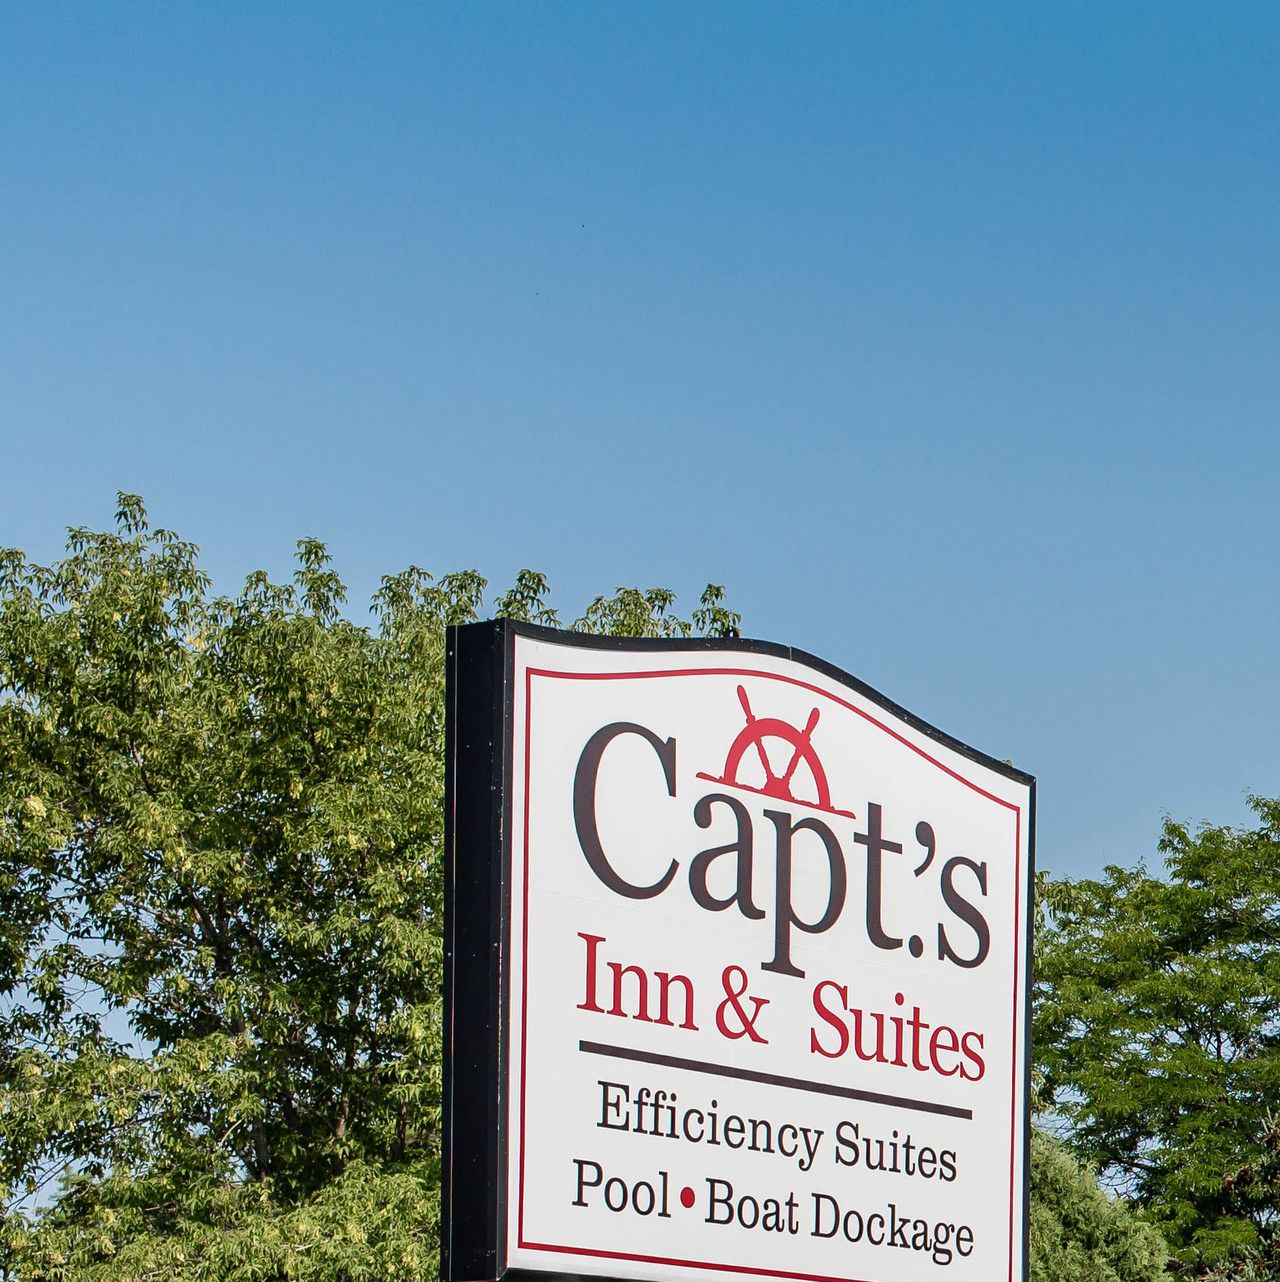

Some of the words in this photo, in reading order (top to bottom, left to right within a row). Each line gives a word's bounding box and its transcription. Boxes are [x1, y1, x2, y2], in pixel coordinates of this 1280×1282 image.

[576, 931, 699, 1032] Inn
[715, 964, 771, 1045] &
[810, 980, 987, 1082] Suites
[596, 1080, 825, 1172] Efficiency
[835, 1120, 958, 1183] Suites
[571, 1158, 672, 1219] Pool
[704, 1177, 799, 1235] Boat
[810, 1192, 975, 1266] Dockage
